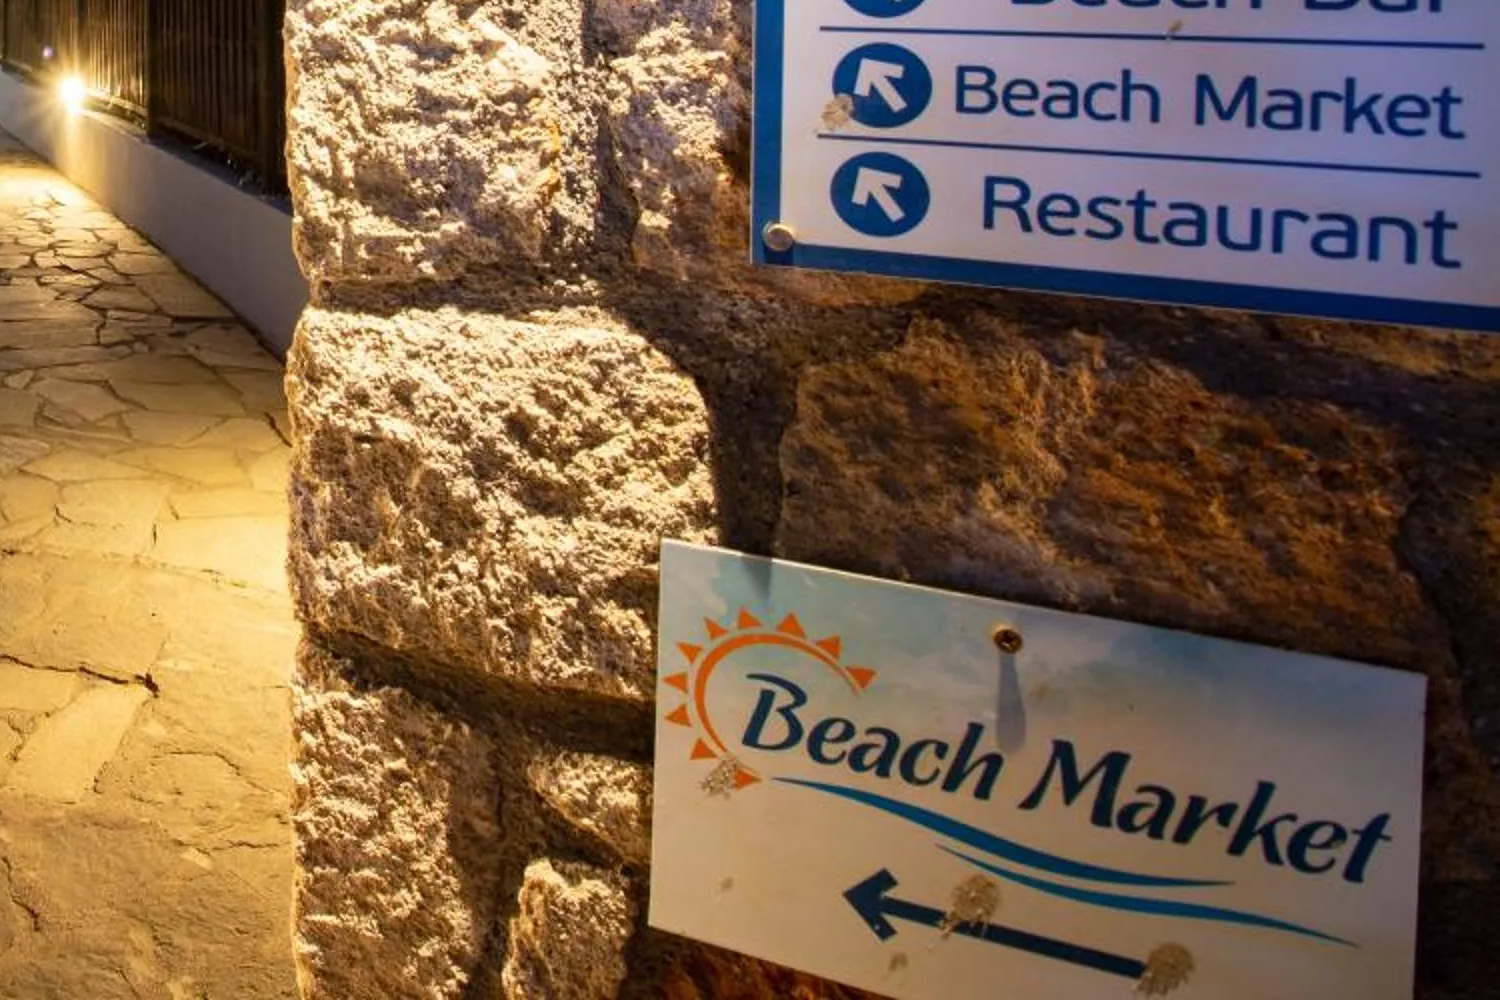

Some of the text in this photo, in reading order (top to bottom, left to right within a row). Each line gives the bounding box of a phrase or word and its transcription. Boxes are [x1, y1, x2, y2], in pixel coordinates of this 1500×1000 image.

[955, 64, 1466, 140] Beach Market
[983, 175, 1462, 270] Restaurant
[741, 672, 1393, 883] Beach Market
